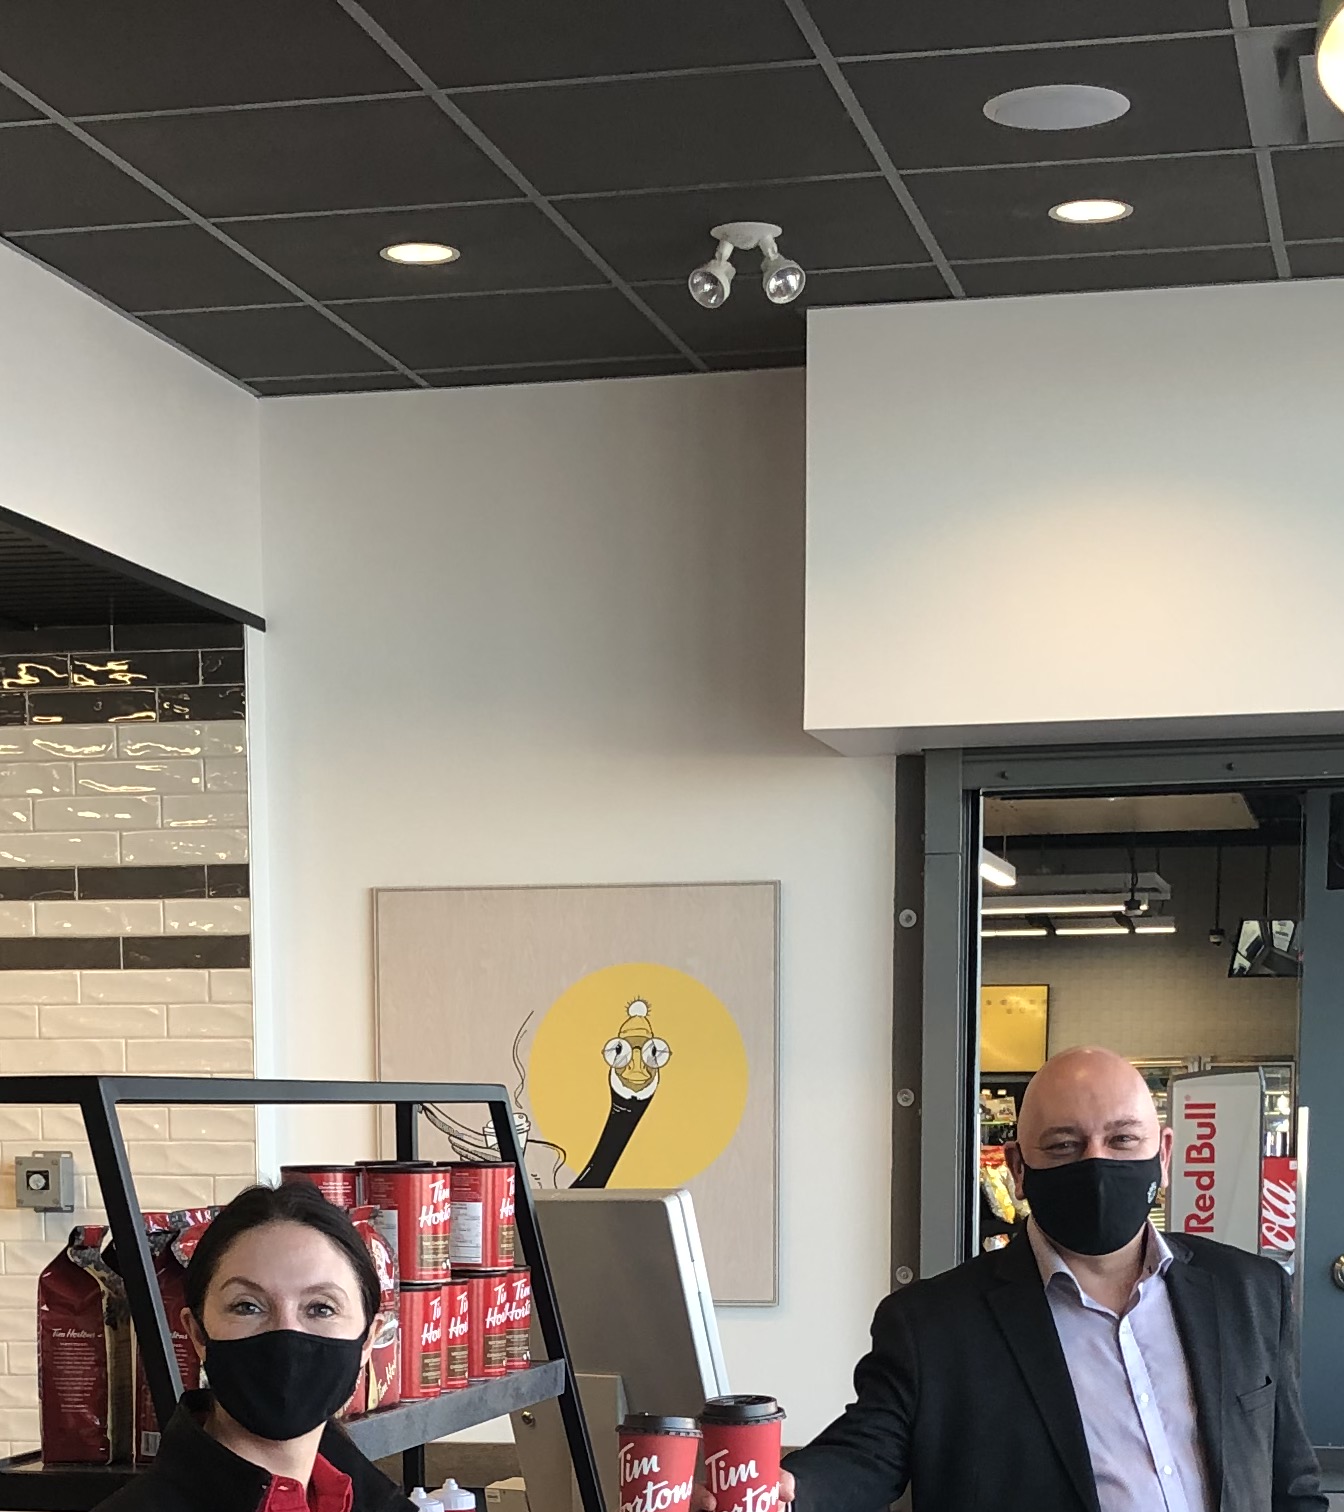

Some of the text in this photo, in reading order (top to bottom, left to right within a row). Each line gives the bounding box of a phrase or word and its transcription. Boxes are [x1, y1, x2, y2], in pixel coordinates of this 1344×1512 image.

[1184, 1102, 1216, 1234] Red Bull
[51, 1328, 95, 1339] Tim Hortons
[618, 1442, 660, 1486] Tim
[704, 1449, 759, 1494] Tim
